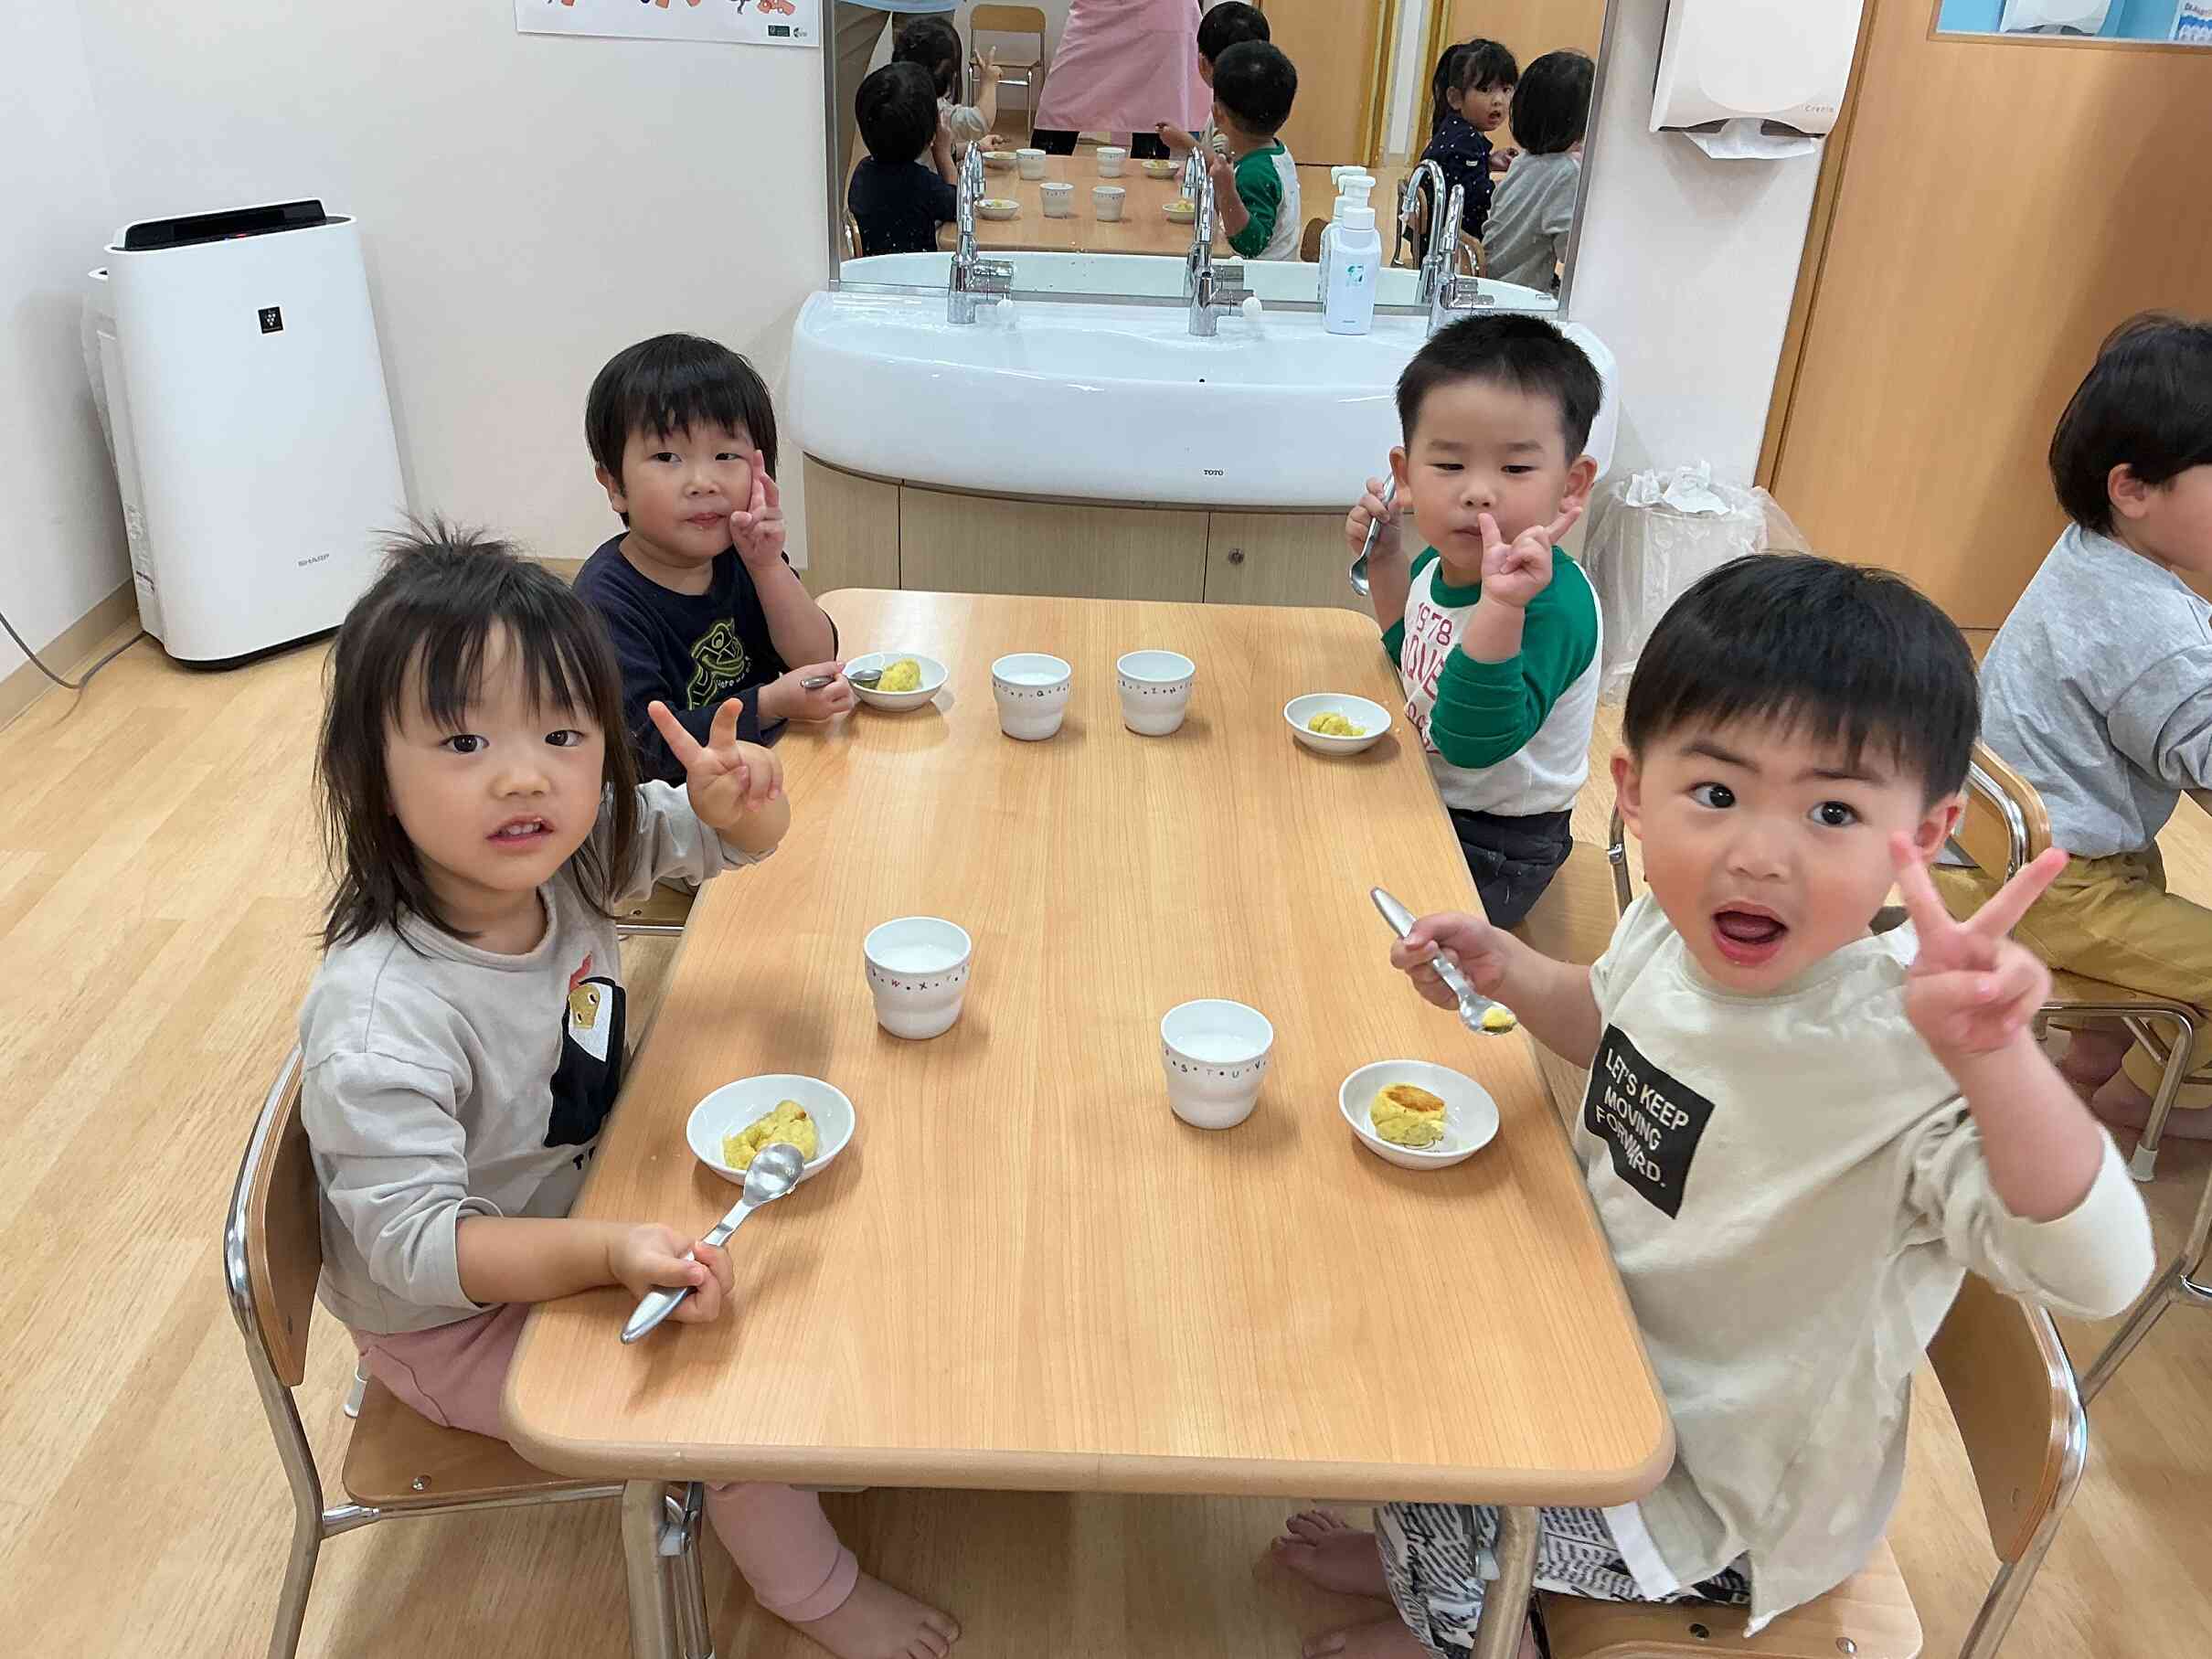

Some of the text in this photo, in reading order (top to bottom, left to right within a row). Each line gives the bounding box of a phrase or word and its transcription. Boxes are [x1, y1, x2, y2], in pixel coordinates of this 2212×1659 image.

[298, 553, 330, 567] SHARP
[1418, 602, 1453, 645] 1978
[1605, 1048, 1689, 1131] LET'S KEEP
[1604, 1085, 1662, 1151] MOVING
